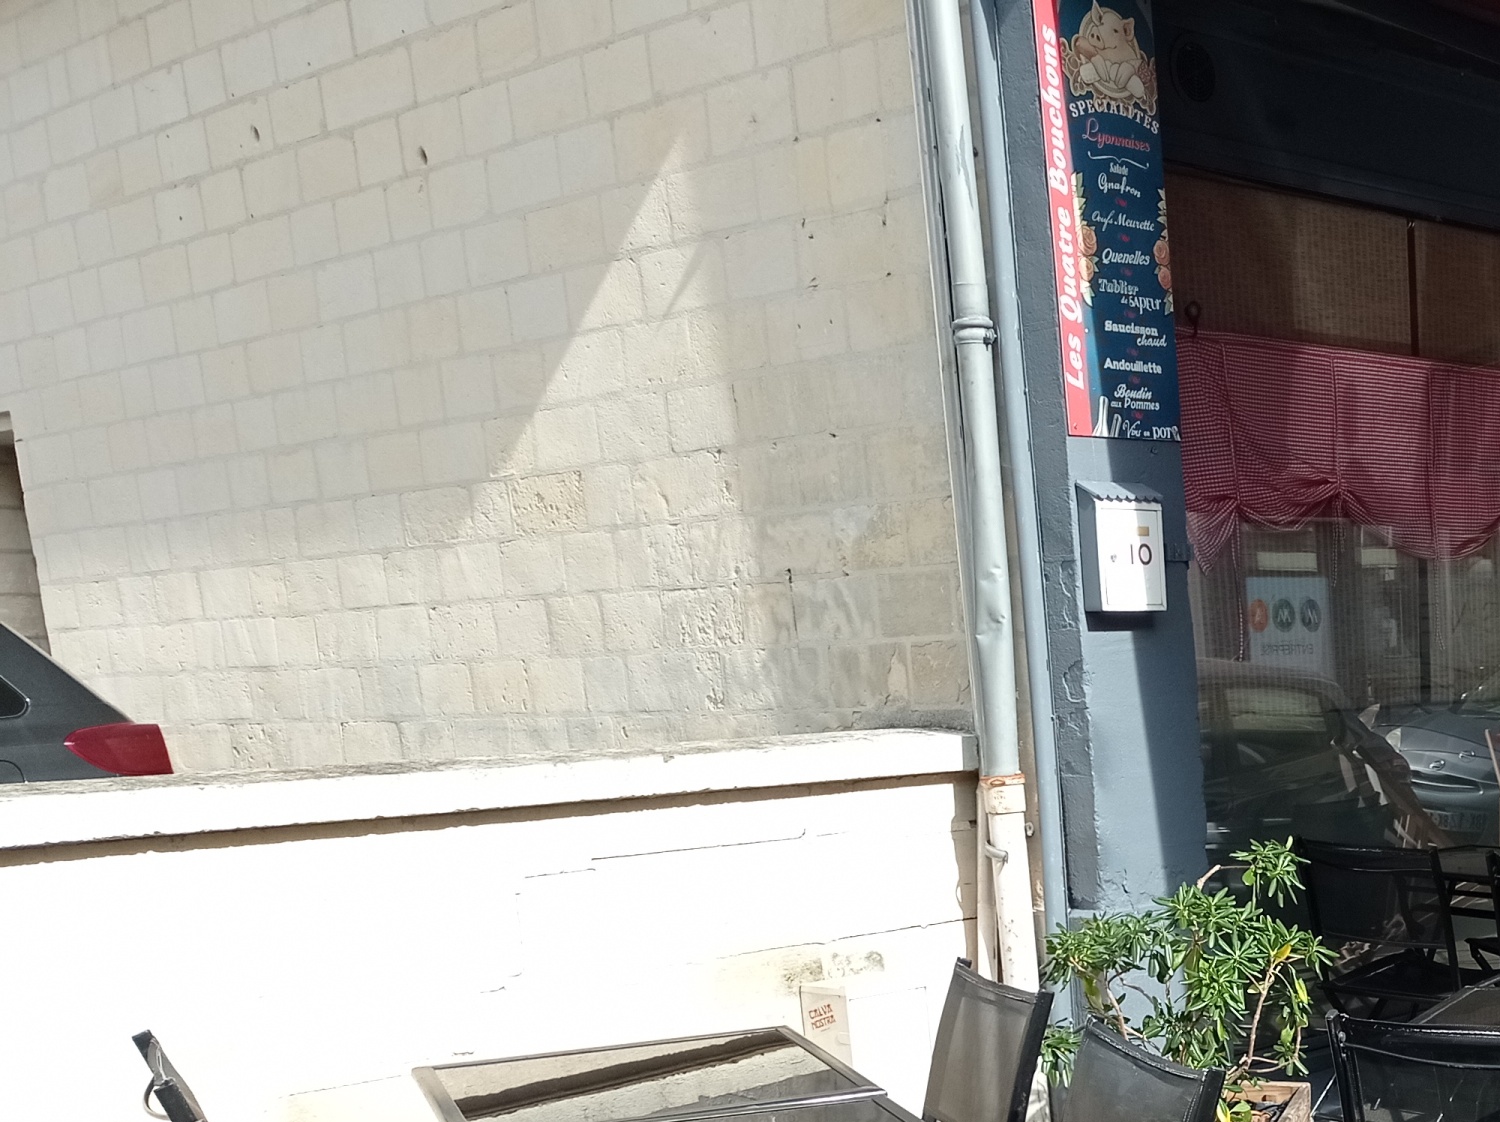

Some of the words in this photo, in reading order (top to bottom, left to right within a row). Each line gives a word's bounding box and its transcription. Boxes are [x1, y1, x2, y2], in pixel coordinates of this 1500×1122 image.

[1041, 24, 1070, 196] Bouchons
[1082, 117, 1150, 152] Lyonnaises
[1098, 173, 1141, 198] Gnafron
[1114, 212, 1155, 232] Meurette
[1057, 206, 1083, 324] Quatre
[1102, 248, 1150, 265] Quenelles
[1098, 278, 1139, 296] Tablier
[1104, 320, 1158, 336] Saucisson
[1137, 335, 1168, 347] chaud
[1065, 333, 1085, 390] Les
[1104, 358, 1162, 374] Andouillette
[1114, 384, 1152, 399] Boudin
[1124, 398, 1160, 411] Pommes
[1130, 543, 1152, 566] 10
[808, 1003, 834, 1020] CALVA
[811, 1014, 837, 1031] NOSTRA
